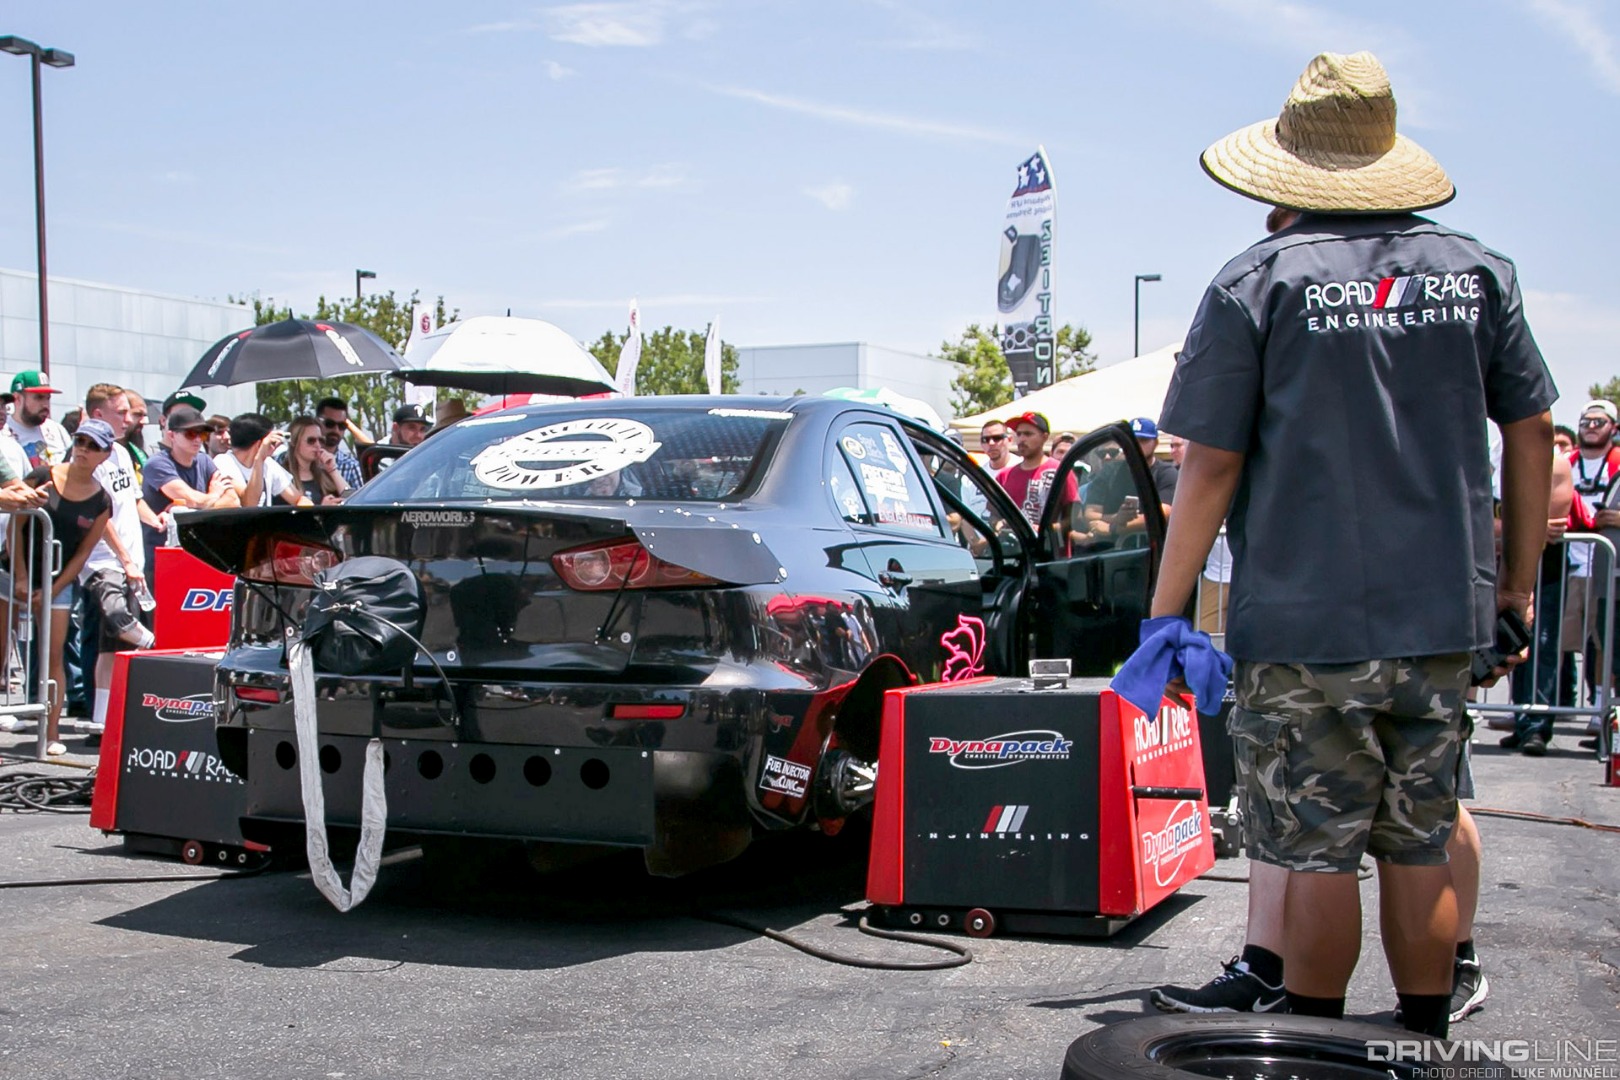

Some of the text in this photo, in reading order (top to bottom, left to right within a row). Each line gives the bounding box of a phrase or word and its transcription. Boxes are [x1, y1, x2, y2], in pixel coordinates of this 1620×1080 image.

[1305, 273, 1480, 310] ROAD RACE
[1307, 305, 1480, 331] ENGINEERING
[127, 747, 177, 769] ROAD
[929, 737, 1073, 759] Dynapack
[765, 758, 810, 781] FUEL INJECTOR
[1142, 808, 1202, 865] Dynapack
